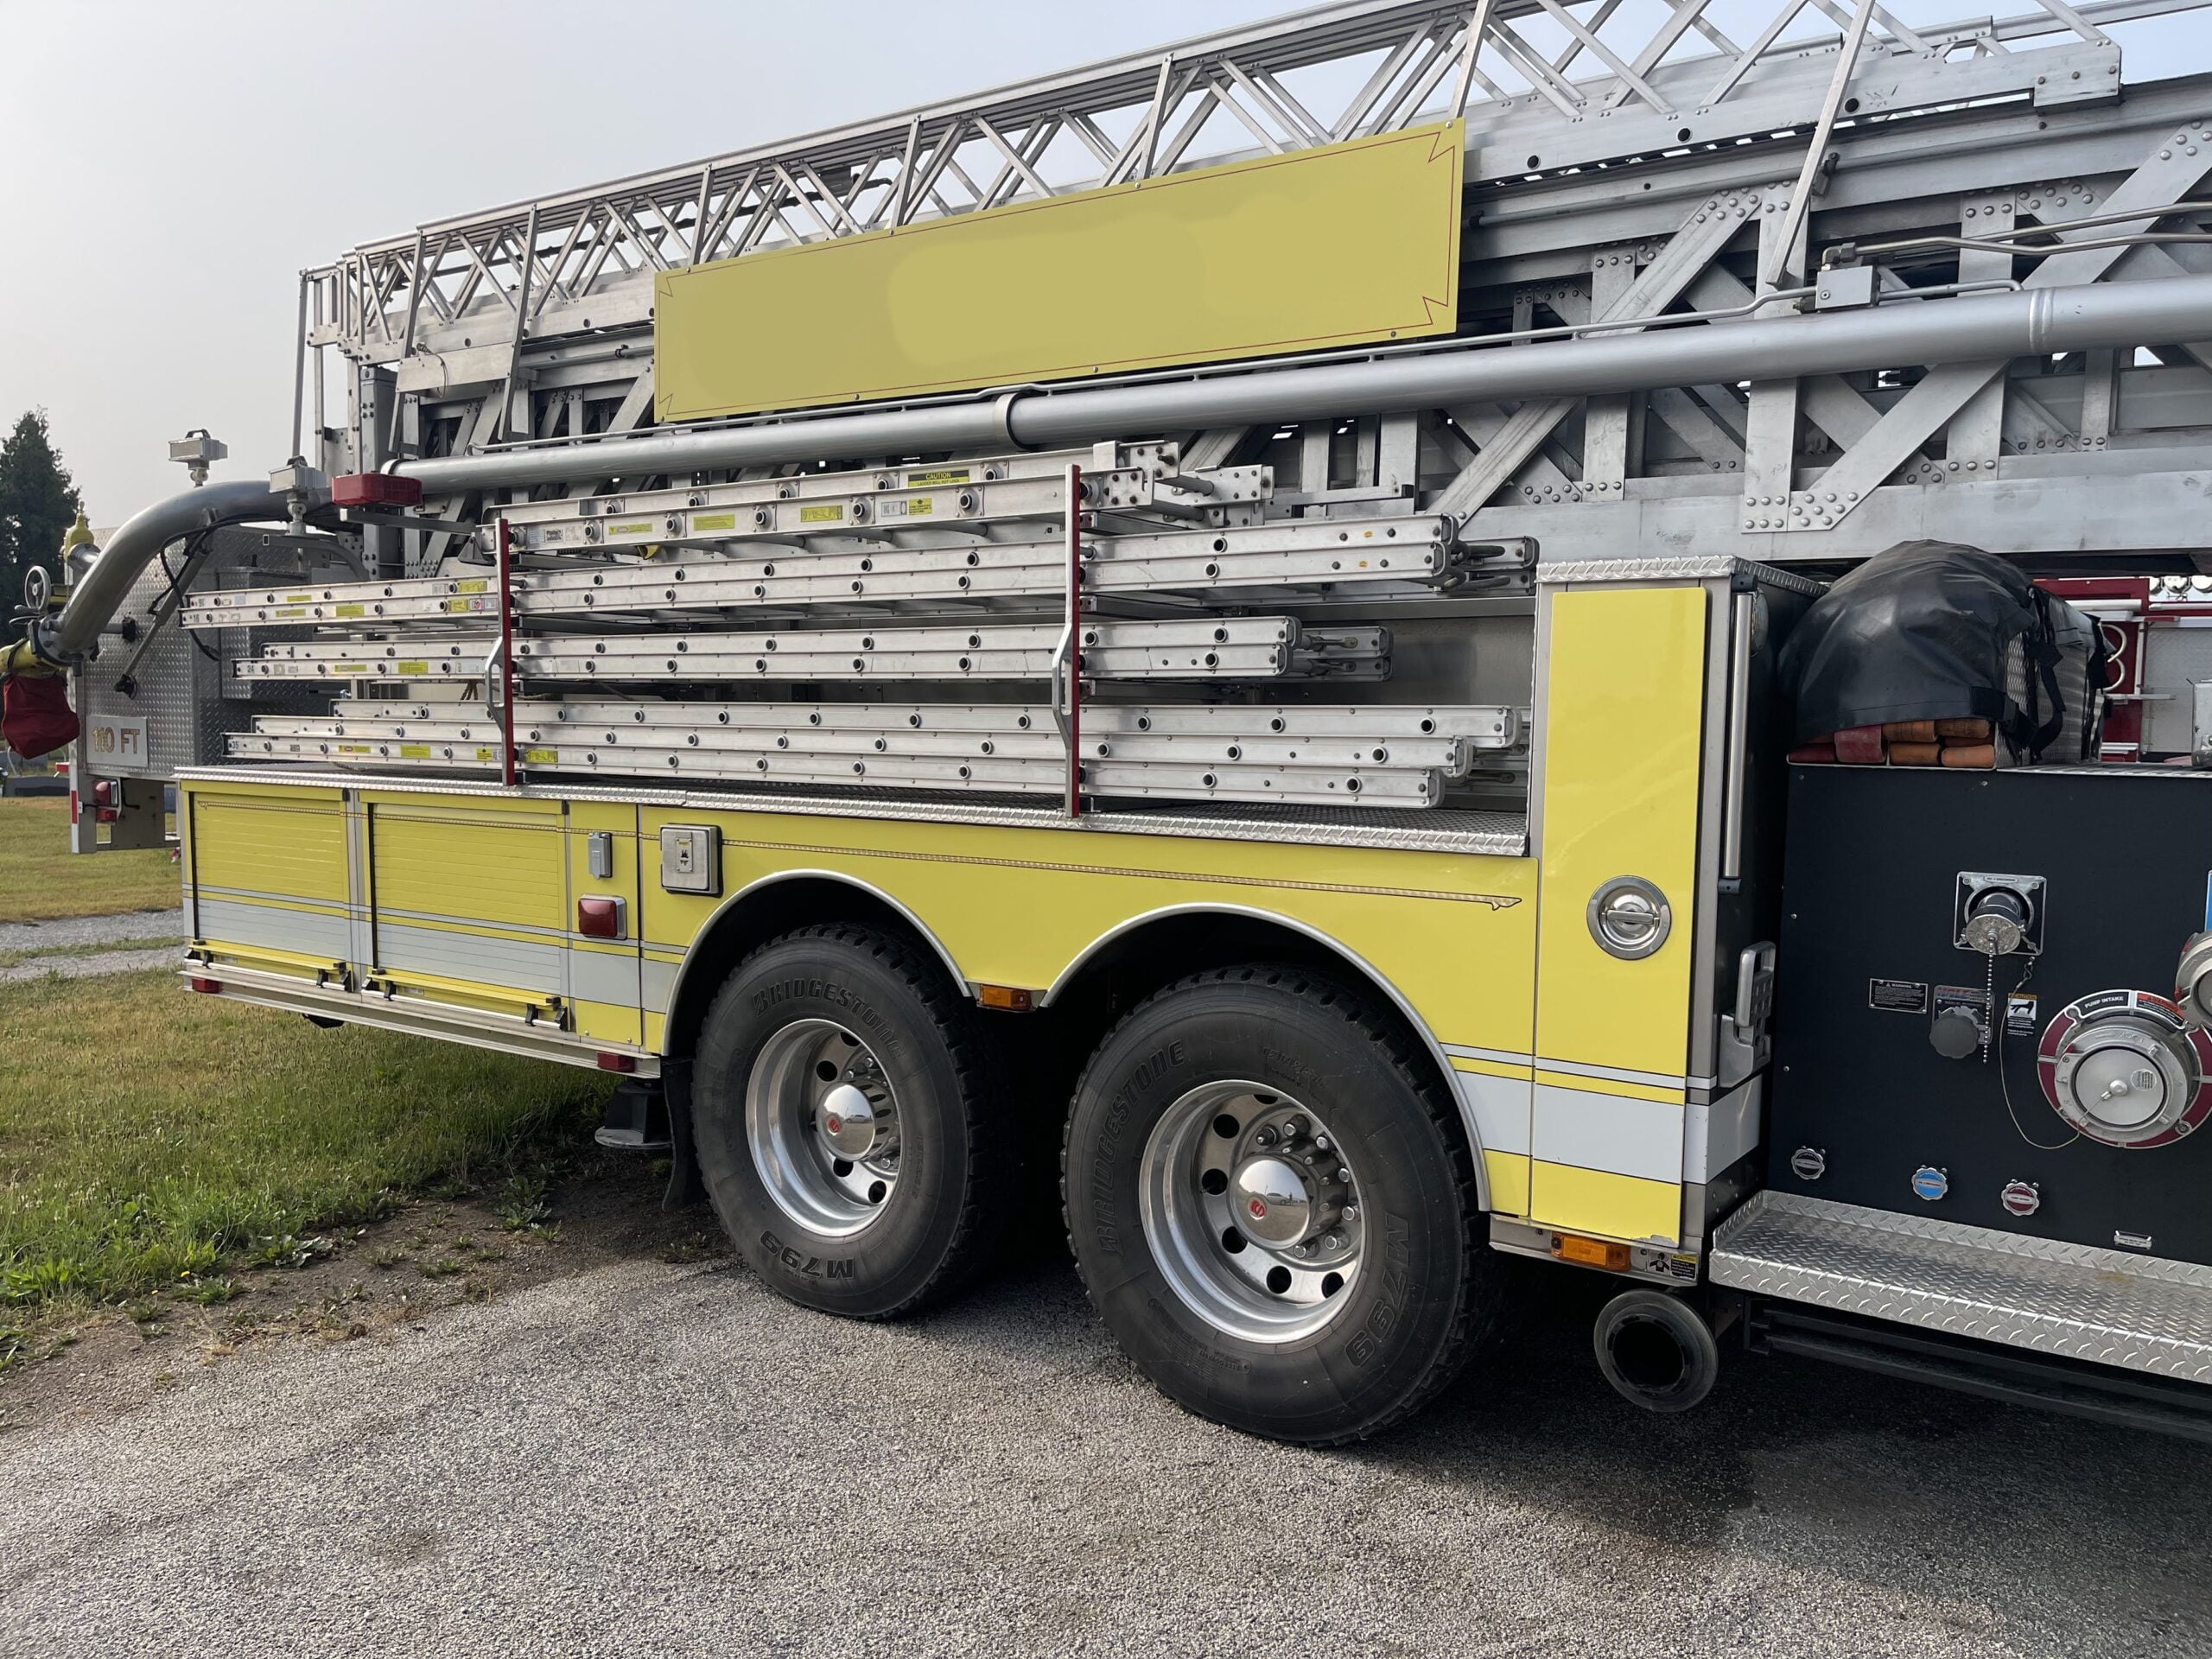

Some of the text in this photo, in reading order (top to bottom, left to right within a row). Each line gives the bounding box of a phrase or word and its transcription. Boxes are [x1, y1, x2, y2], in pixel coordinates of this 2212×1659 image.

[91, 726, 140, 754] 110 FT
[751, 977, 906, 1059] BRIDGESTONE
[2084, 995, 2124, 1008] PUMP INTAKE
[1093, 1038, 1185, 1259] BRIDGESTONE
[760, 1229, 855, 1281] M799
[1344, 1211, 1410, 1368] M799
